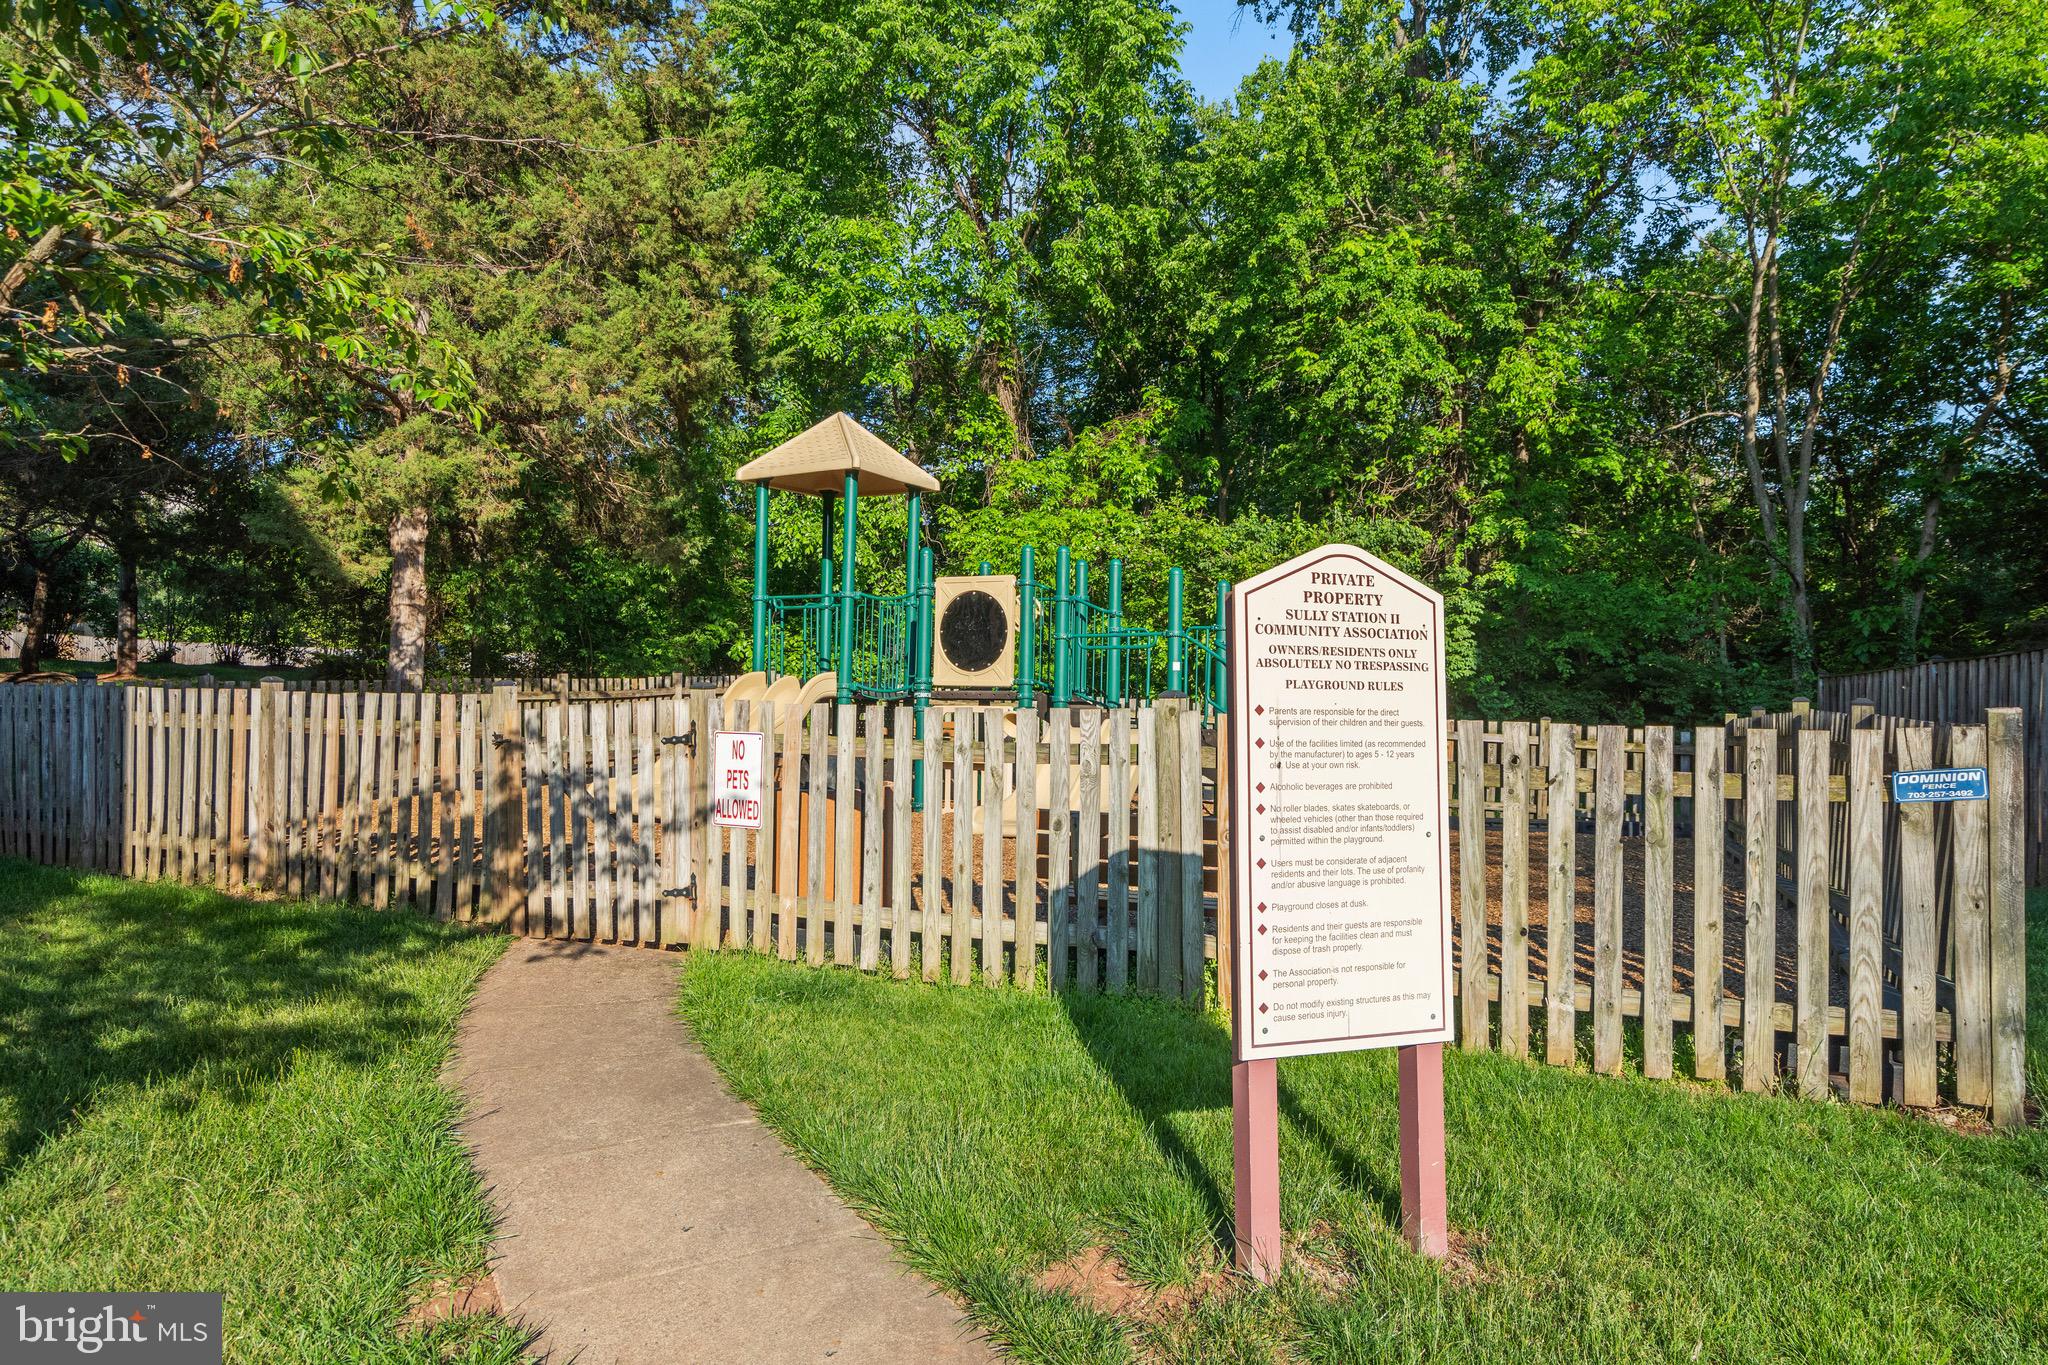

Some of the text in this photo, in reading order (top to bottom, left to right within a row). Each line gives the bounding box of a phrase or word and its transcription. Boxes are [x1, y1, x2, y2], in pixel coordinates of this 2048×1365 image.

[1311, 572, 1375, 587] PRIVATE
[1303, 591, 1383, 606] PROPERTY
[1285, 609, 1400, 624] SULLY STATION II
[1255, 624, 1428, 641] COMMUNITY ASSOCIATION
[1268, 645, 1417, 659] OWNERS/RESIDENTS ONLY
[1256, 658, 1429, 672] ABSOLUTELY NO TRESPASSING
[1285, 680, 1404, 691] PLAYGROUND RULES
[1269, 707, 1297, 715] Parents
[1314, 708, 1354, 717] responsible
[1356, 708, 1366, 716] for
[1368, 708, 1378, 716] the
[1380, 708, 1399, 717] direct
[1269, 718, 1424, 728] supervision of their children and their guests.
[732, 740, 745, 760] NO
[1309, 740, 1338, 748] facilities
[1340, 740, 1362, 748] limited
[1365, 740, 1376, 748] (as
[1378, 740, 1426, 748] recommended
[1270, 751, 1278, 760] by
[1294, 751, 1345, 759] manufacturer)
[1286, 761, 1300, 769] Use
[1311, 762, 1327, 770] your
[1346, 761, 1360, 769] risk.
[727, 770, 749, 790] PETS
[1898, 772, 1980, 784] DOMINION
[1270, 783, 1303, 791] Alcoholic
[1305, 783, 1343, 792] beverages
[1358, 782, 1392, 791] prohibited
[1908, 790, 1973, 798] 703-257-3492
[716, 799, 759, 820] ALLOWED
[1304, 804, 1330, 812] blades,
[1270, 816, 1301, 824] wheeled
[1304, 815, 1333, 823] vehicles
[1335, 815, 1355, 823] (other
[1358, 814, 1373, 822] than
[1395, 813, 1423, 822] required
[1279, 826, 1301, 834] assist
[1336, 825, 1358, 833] and/or
[1270, 835, 1384, 846] permitted within the playground.
[1271, 856, 1407, 868] Users must be considerate of adjacent
[1271, 870, 1305, 878] residents
[1307, 869, 1321, 877] and
[1323, 868, 1338, 877] their
[1340, 868, 1355, 876] lots.
[1357, 867, 1371, 875] The
[1396, 866, 1425, 875] profanity
[1272, 877, 1406, 890] and/or abusive language is prohibited.
[1272, 902, 1313, 912] Playground
[1316, 902, 1339, 910] closes
[1350, 900, 1368, 908] dusk.
[1272, 924, 1309, 933] Residents
[1311, 923, 1325, 932] and
[1327, 922, 1343, 931] their
[1345, 921, 1368, 931] guests
[1384, 918, 1423, 929] responsible
[1272, 937, 1282, 945] for
[1284, 935, 1314, 945] keeping
[1316, 934, 1327, 942] the
[1329, 933, 1358, 941] facilities
[1360, 932, 1378, 940] clean
[1396, 929, 1412, 937] must
[1272, 943, 1363, 957] dispose of trash properly.
[1273, 961, 1406, 978] The Association is not responsible for
[1273, 977, 1338, 990] personal property.
[1273, 1003, 1284, 1011] Do
[1286, 1002, 1298, 1010] not
[1300, 999, 1324, 1010] modify
[1327, 998, 1354, 1007] existing
[1356, 995, 1391, 1005] structures
[1403, 992, 1415, 1001] this
[1417, 992, 1431, 1001] may
[1273, 1009, 1347, 1022] cause serious injury.
